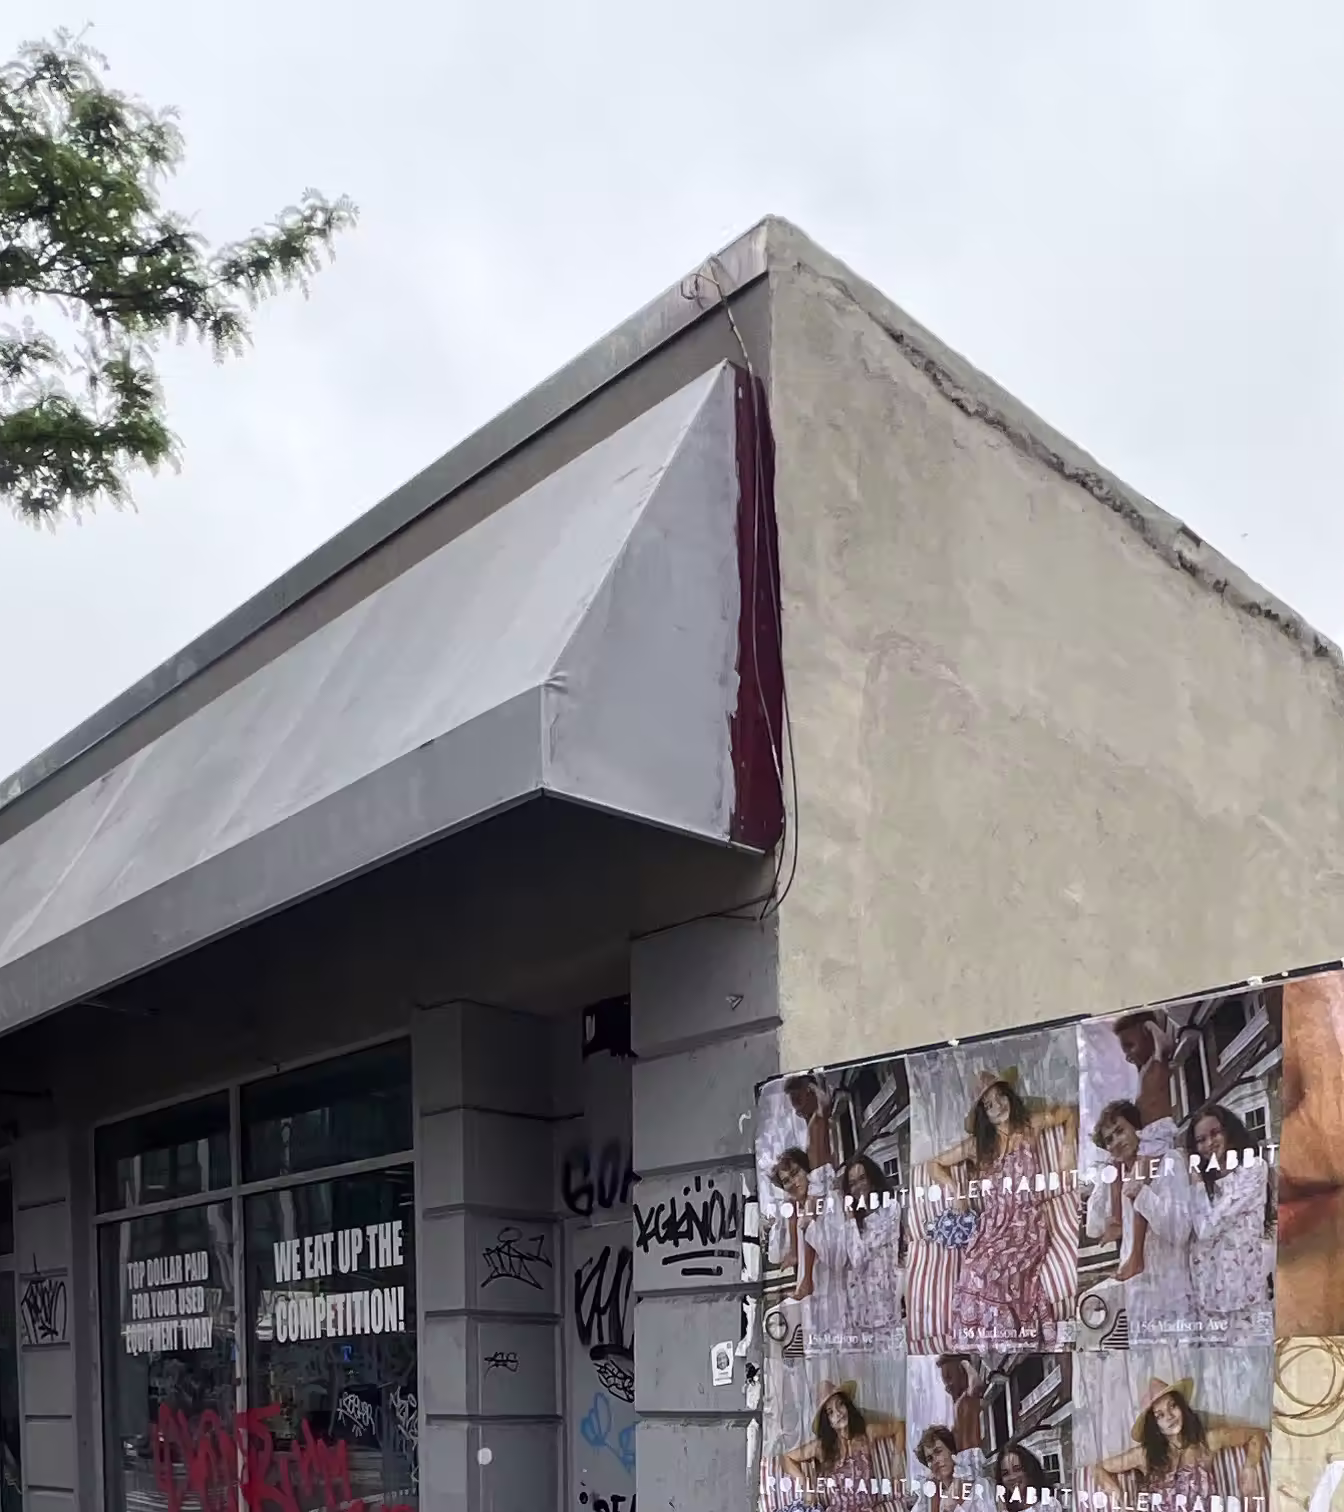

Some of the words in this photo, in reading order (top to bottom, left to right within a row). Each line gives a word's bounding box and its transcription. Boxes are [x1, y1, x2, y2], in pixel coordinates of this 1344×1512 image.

[1083, 1158, 1175, 1184] ROLLER
[1189, 1145, 1279, 1174] RABBIT
[915, 1179, 992, 1202] ROLLER
[1002, 1170, 1078, 1194] RABBIT
[766, 1197, 834, 1219] ROLLER
[844, 1188, 909, 1211] RABBIT
[273, 1240, 301, 1283] WE
[304, 1232, 335, 1279] EAT
[338, 1228, 362, 1273] UP
[366, 1220, 403, 1269] THE
[128, 1262, 145, 1289] TOP
[147, 1255, 183, 1286] DOLLAR
[184, 1251, 208, 1282] PAID
[132, 1292, 151, 1319] FOR
[152, 1289, 177, 1317] YOUR
[179, 1286, 204, 1314] USED
[275, 1286, 405, 1343] COMPETITION!
[125, 1319, 178, 1356] EQUIPMENT
[181, 1317, 212, 1349] TODAY
[1018, 1326, 1037, 1339] Ave
[1206, 1318, 1229, 1331] Ave
[767, 1476, 836, 1495] ROLLER
[844, 1477, 907, 1496] RABBIT
[911, 1479, 985, 1501] ROLLER
[996, 1485, 1072, 1505] RABBIT
[1078, 1491, 1164, 1512] ROLLER
